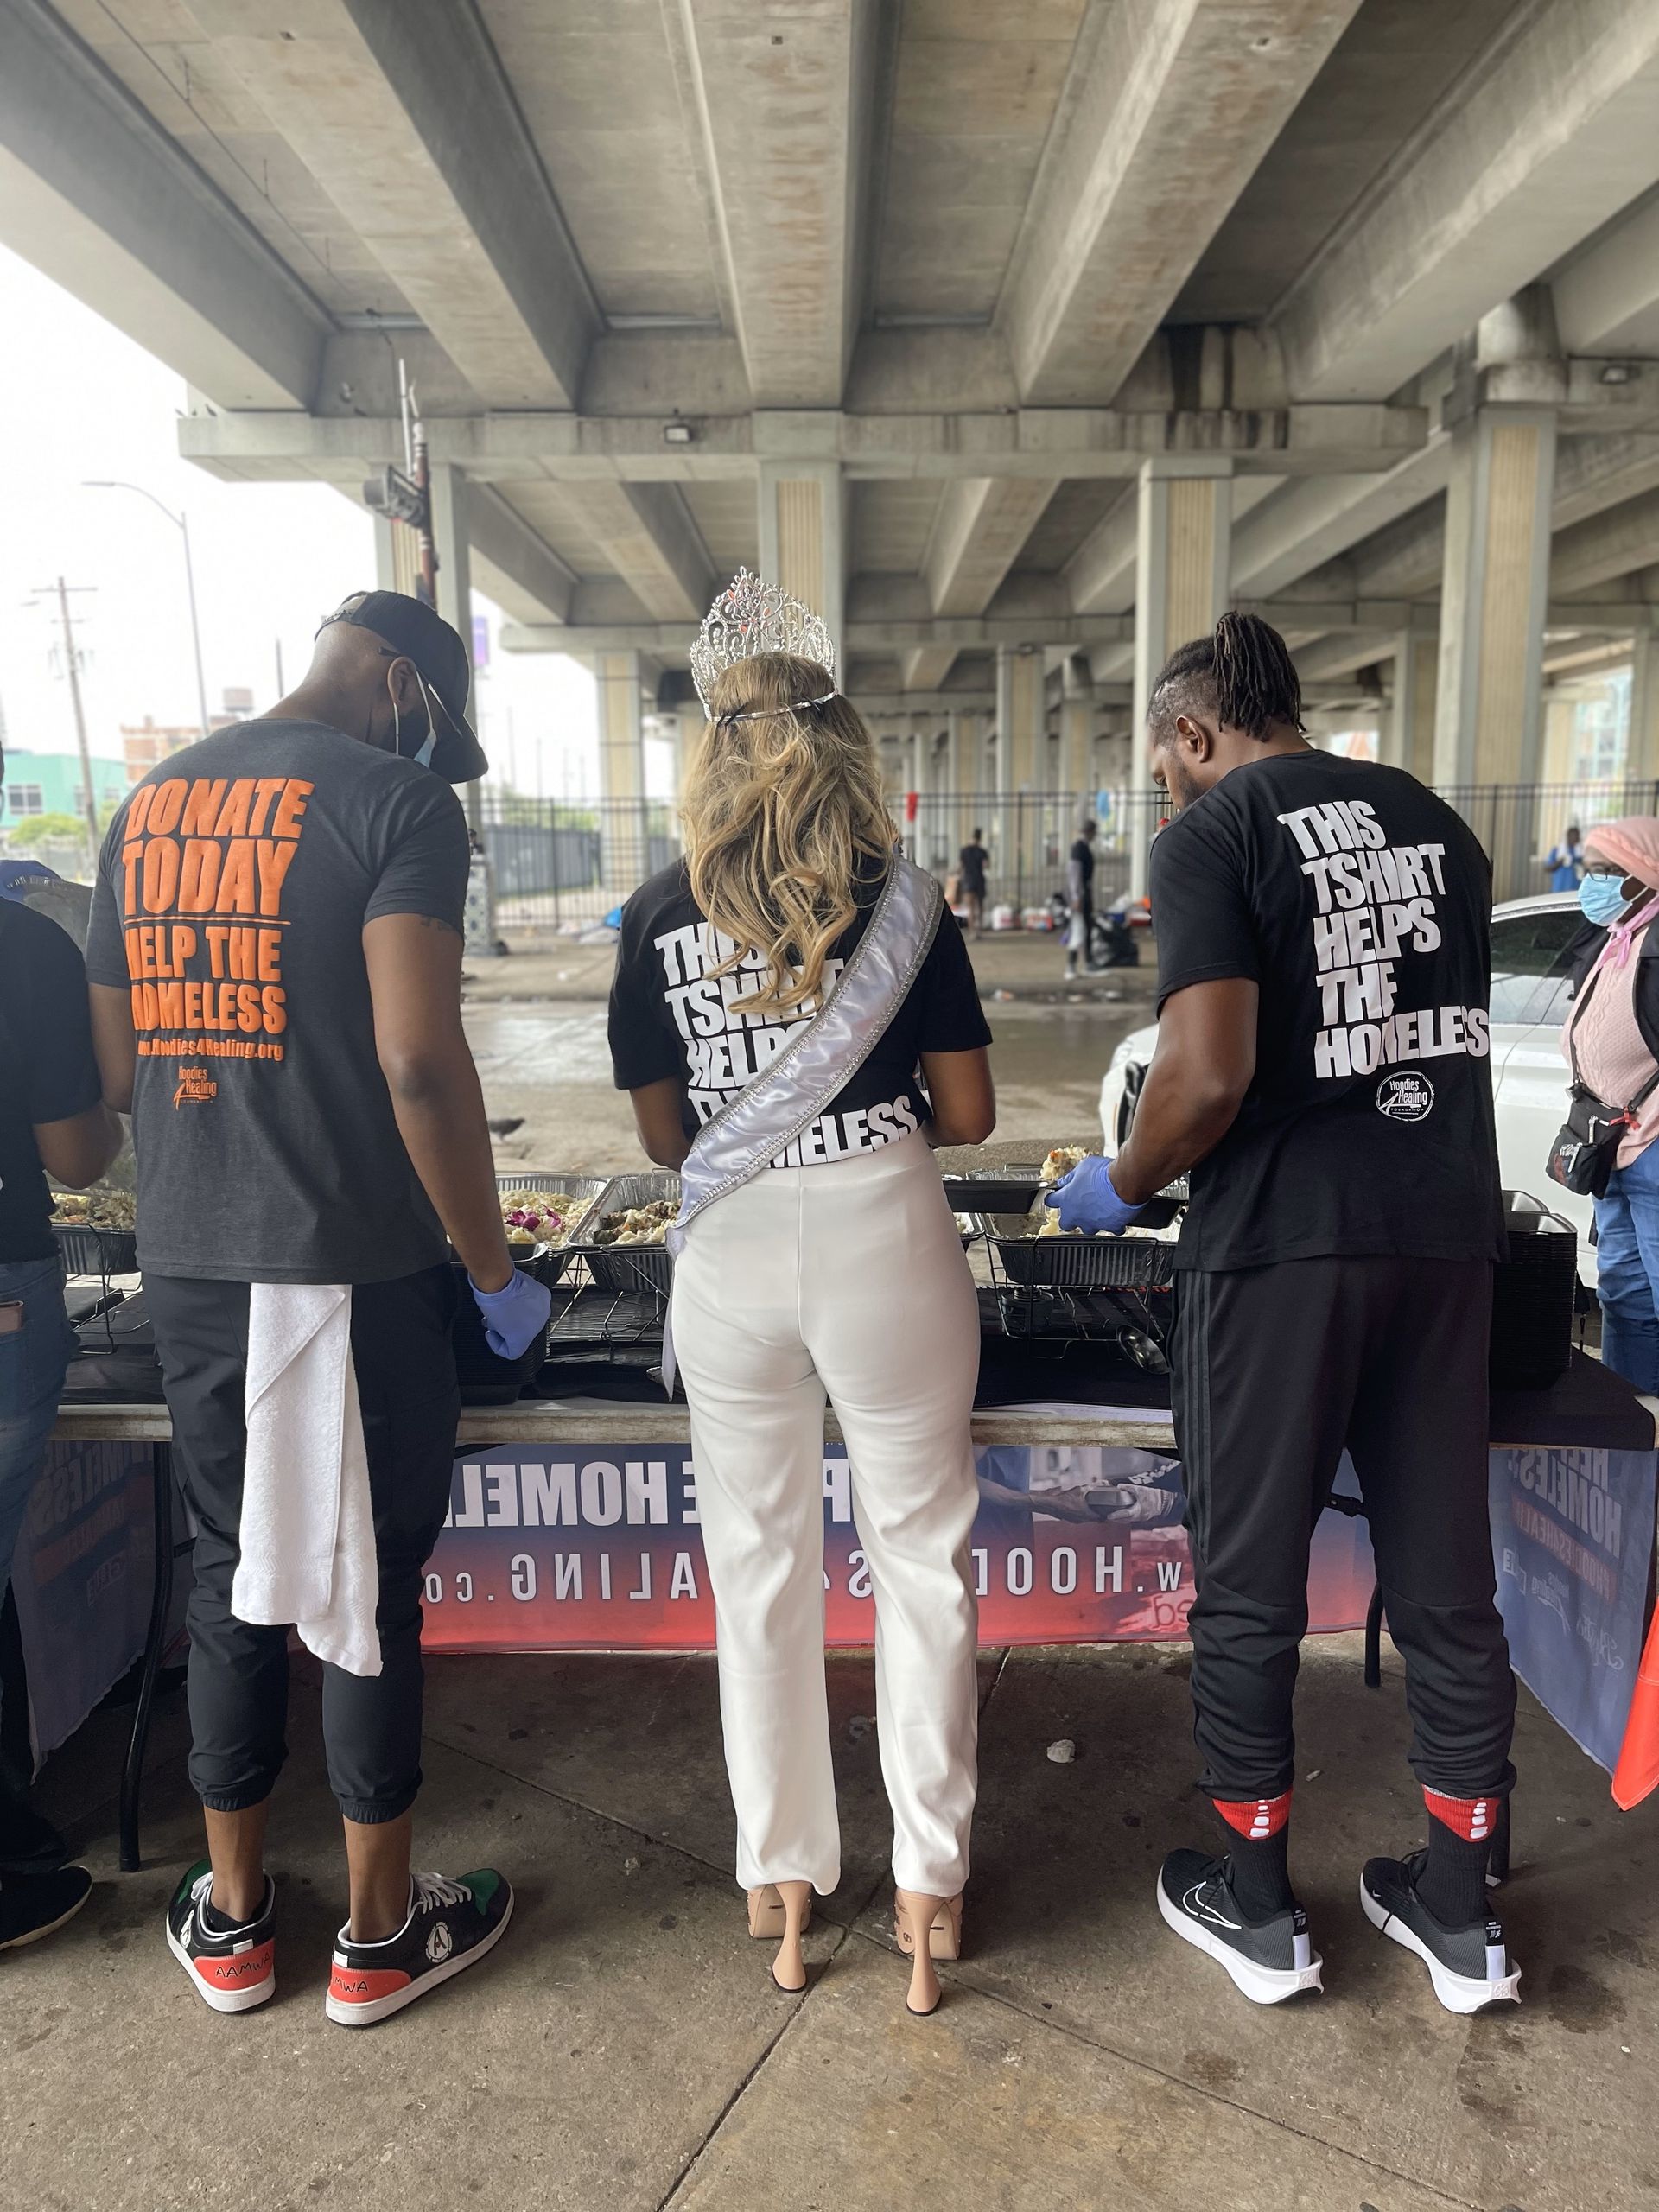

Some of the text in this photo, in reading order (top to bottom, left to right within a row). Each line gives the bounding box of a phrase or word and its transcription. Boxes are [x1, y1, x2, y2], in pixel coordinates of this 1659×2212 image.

[126, 779, 315, 838] DONATE
[1277, 800, 1387, 859] THIS
[123, 836, 299, 917] TODAY
[1300, 843, 1446, 914] TSHIRT
[124, 925, 283, 982] HELP THE
[1313, 897, 1441, 972] HELPS
[684, 1020, 812, 1089] HELP
[1314, 1005, 1490, 1079] HOELES
[186, 1079, 217, 1097] Healing
[1389, 1077, 1420, 1091] Hoodies
[1398, 1090, 1428, 1106] Healing
[761, 1095, 918, 1169] ELESS
